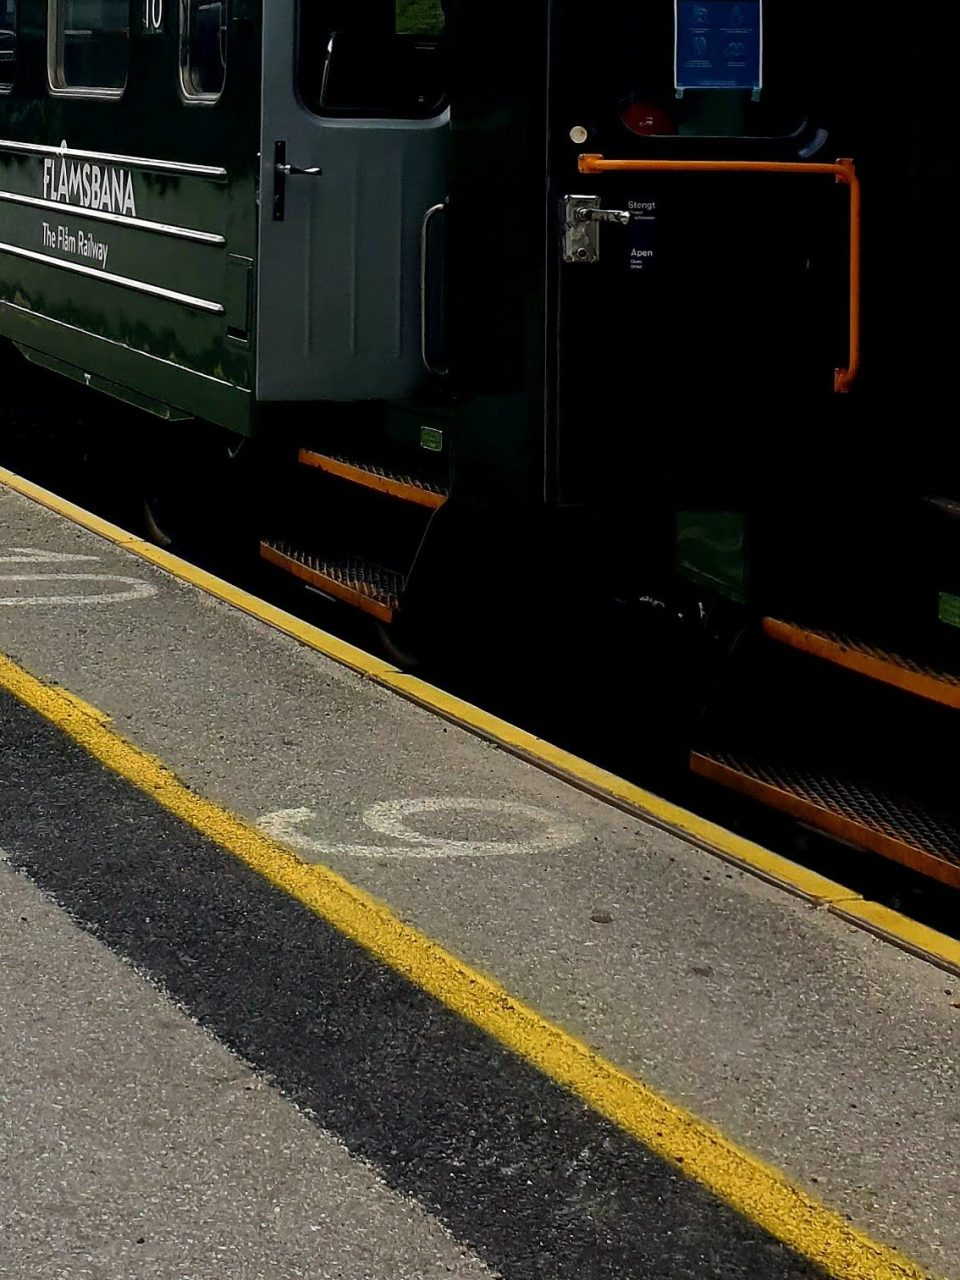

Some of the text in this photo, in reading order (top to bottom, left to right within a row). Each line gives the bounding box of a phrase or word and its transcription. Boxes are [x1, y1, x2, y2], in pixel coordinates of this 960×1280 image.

[43, 139, 136, 216] FLÅMSBANA
[42, 222, 109, 269] The Flåm Railway
